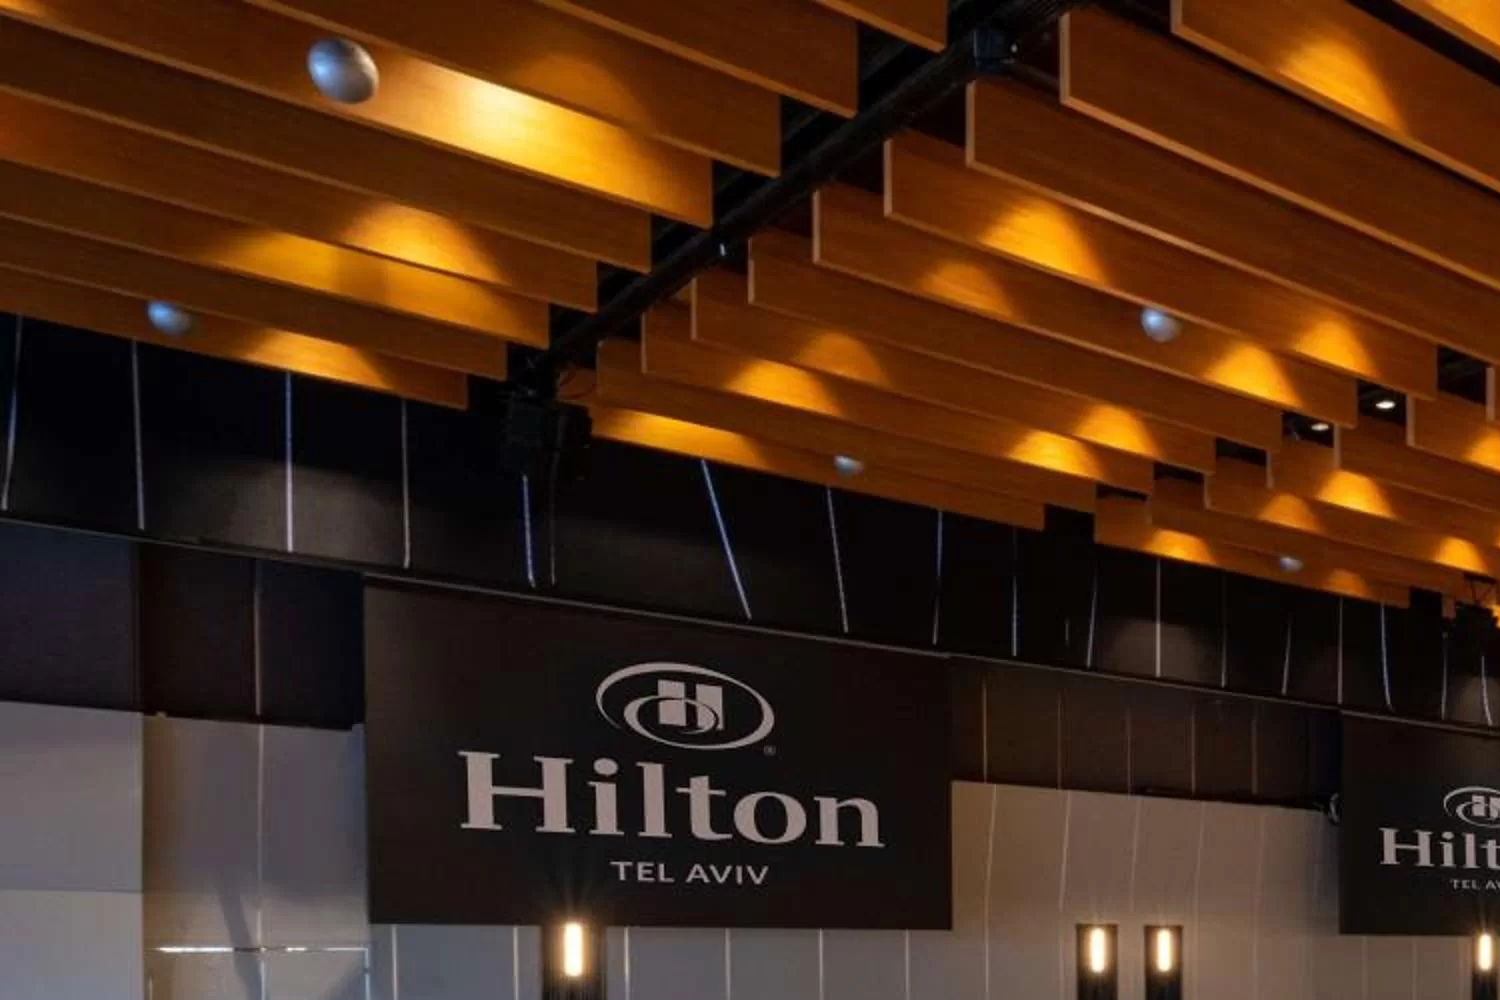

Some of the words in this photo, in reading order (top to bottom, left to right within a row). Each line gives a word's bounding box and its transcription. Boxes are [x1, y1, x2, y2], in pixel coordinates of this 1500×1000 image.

[457, 750, 886, 849] Hilton
[610, 861, 676, 883] TEL
[685, 863, 770, 886] AVIV
[1452, 879, 1480, 890] TEL
